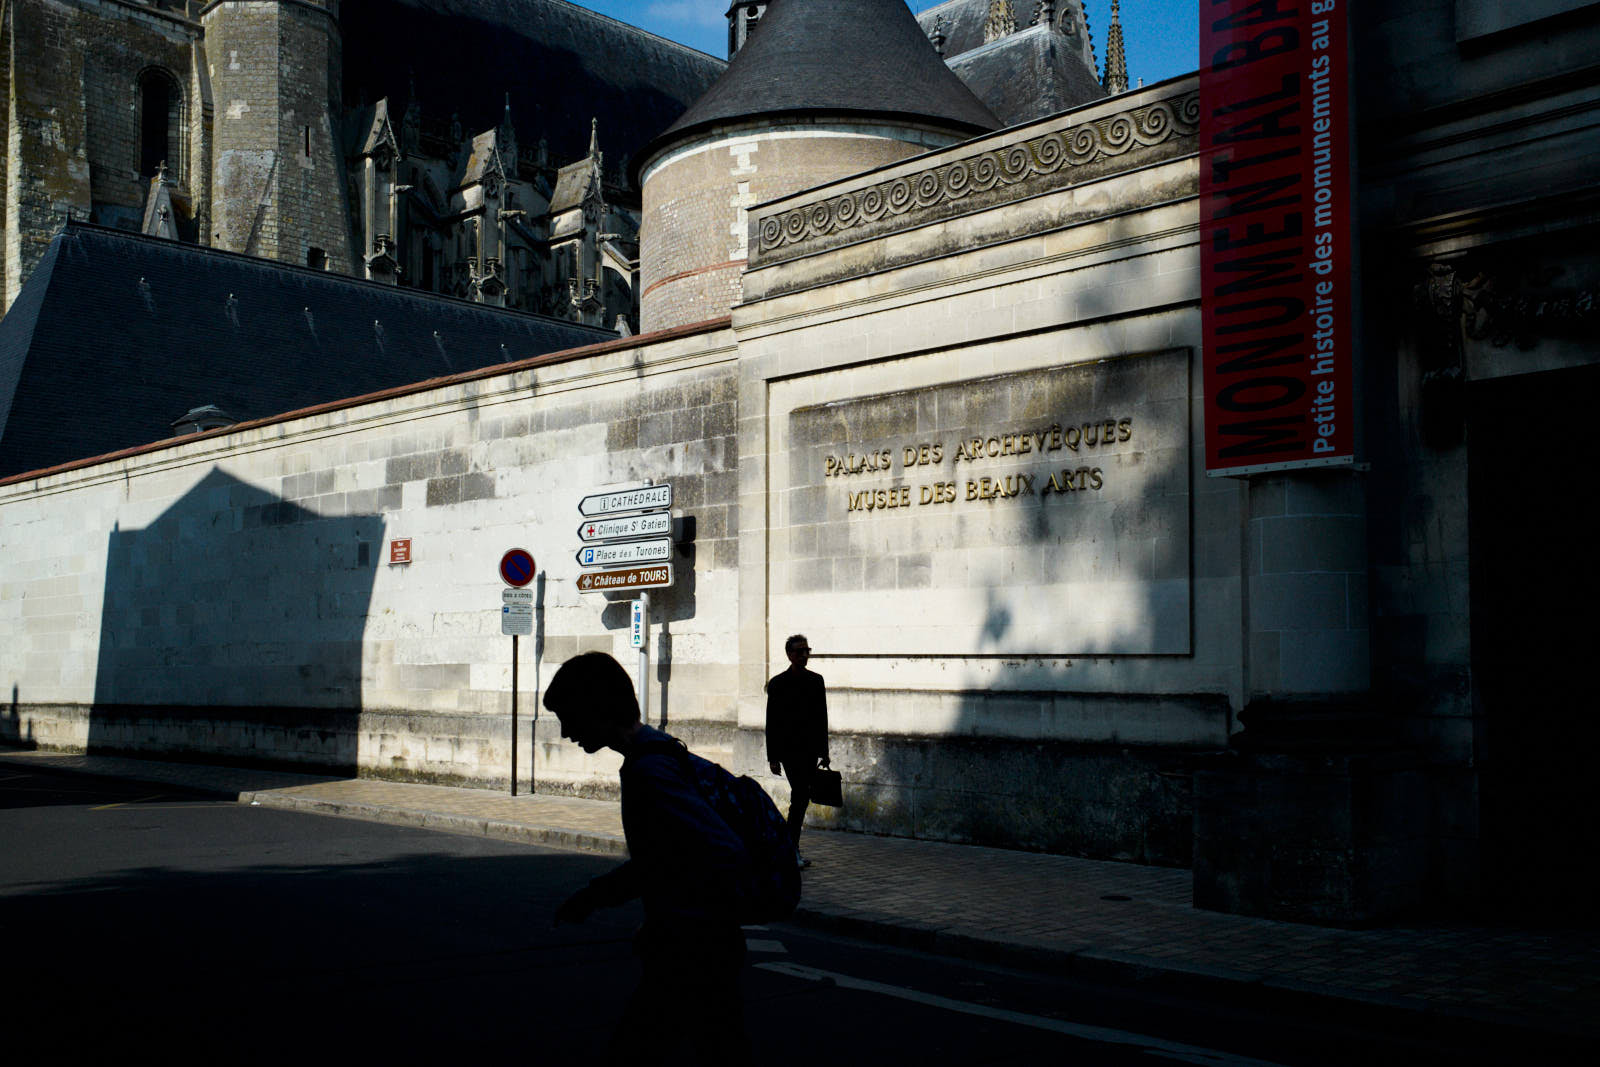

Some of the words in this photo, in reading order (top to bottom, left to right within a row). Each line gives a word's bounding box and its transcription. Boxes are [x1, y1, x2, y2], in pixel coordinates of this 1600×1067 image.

[1212, 0, 1300, 73] BA
[1311, 19, 1330, 51] au
[1213, 72, 1306, 459] MONUMENTAL
[1309, 232, 1333, 275] des
[1309, 281, 1334, 375] histoire
[1311, 381, 1336, 453] Petite
[825, 449, 892, 477] PALAIS
[903, 442, 943, 468] DES
[954, 417, 1133, 463] ARCHEVÊQUES
[919, 481, 957, 505] DES
[965, 473, 1037, 502] BEAUX
[1043, 466, 1104, 492] ARTS
[598, 524, 629, 535] Clinique
[641, 519, 667, 530] Gatien
[596, 550, 617, 560] Place
[619, 549, 632, 558] des
[636, 546, 667, 557] Turones
[594, 575, 626, 586] Château
[627, 572, 638, 583] de
[640, 569, 667, 582] TOURS
